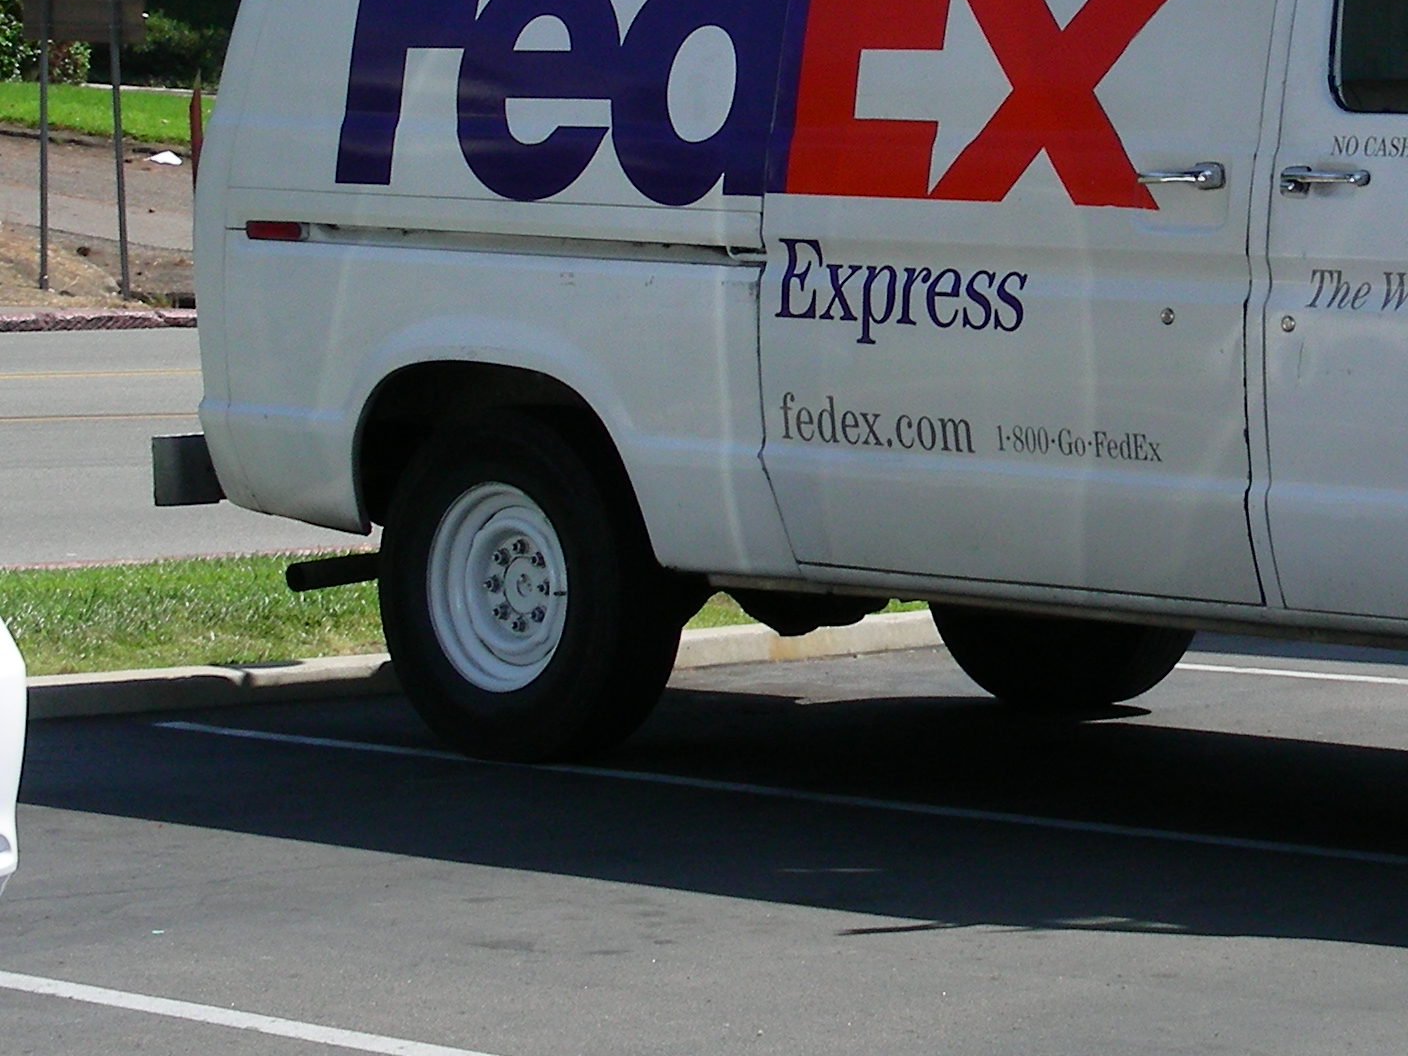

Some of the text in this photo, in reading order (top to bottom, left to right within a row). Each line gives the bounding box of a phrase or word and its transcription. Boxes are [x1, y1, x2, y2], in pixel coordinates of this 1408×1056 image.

[1330, 135, 1359, 157] NO
[775, 238, 1028, 344] Express
[1305, 269, 1372, 312] The
[780, 391, 976, 454] fedex.com
